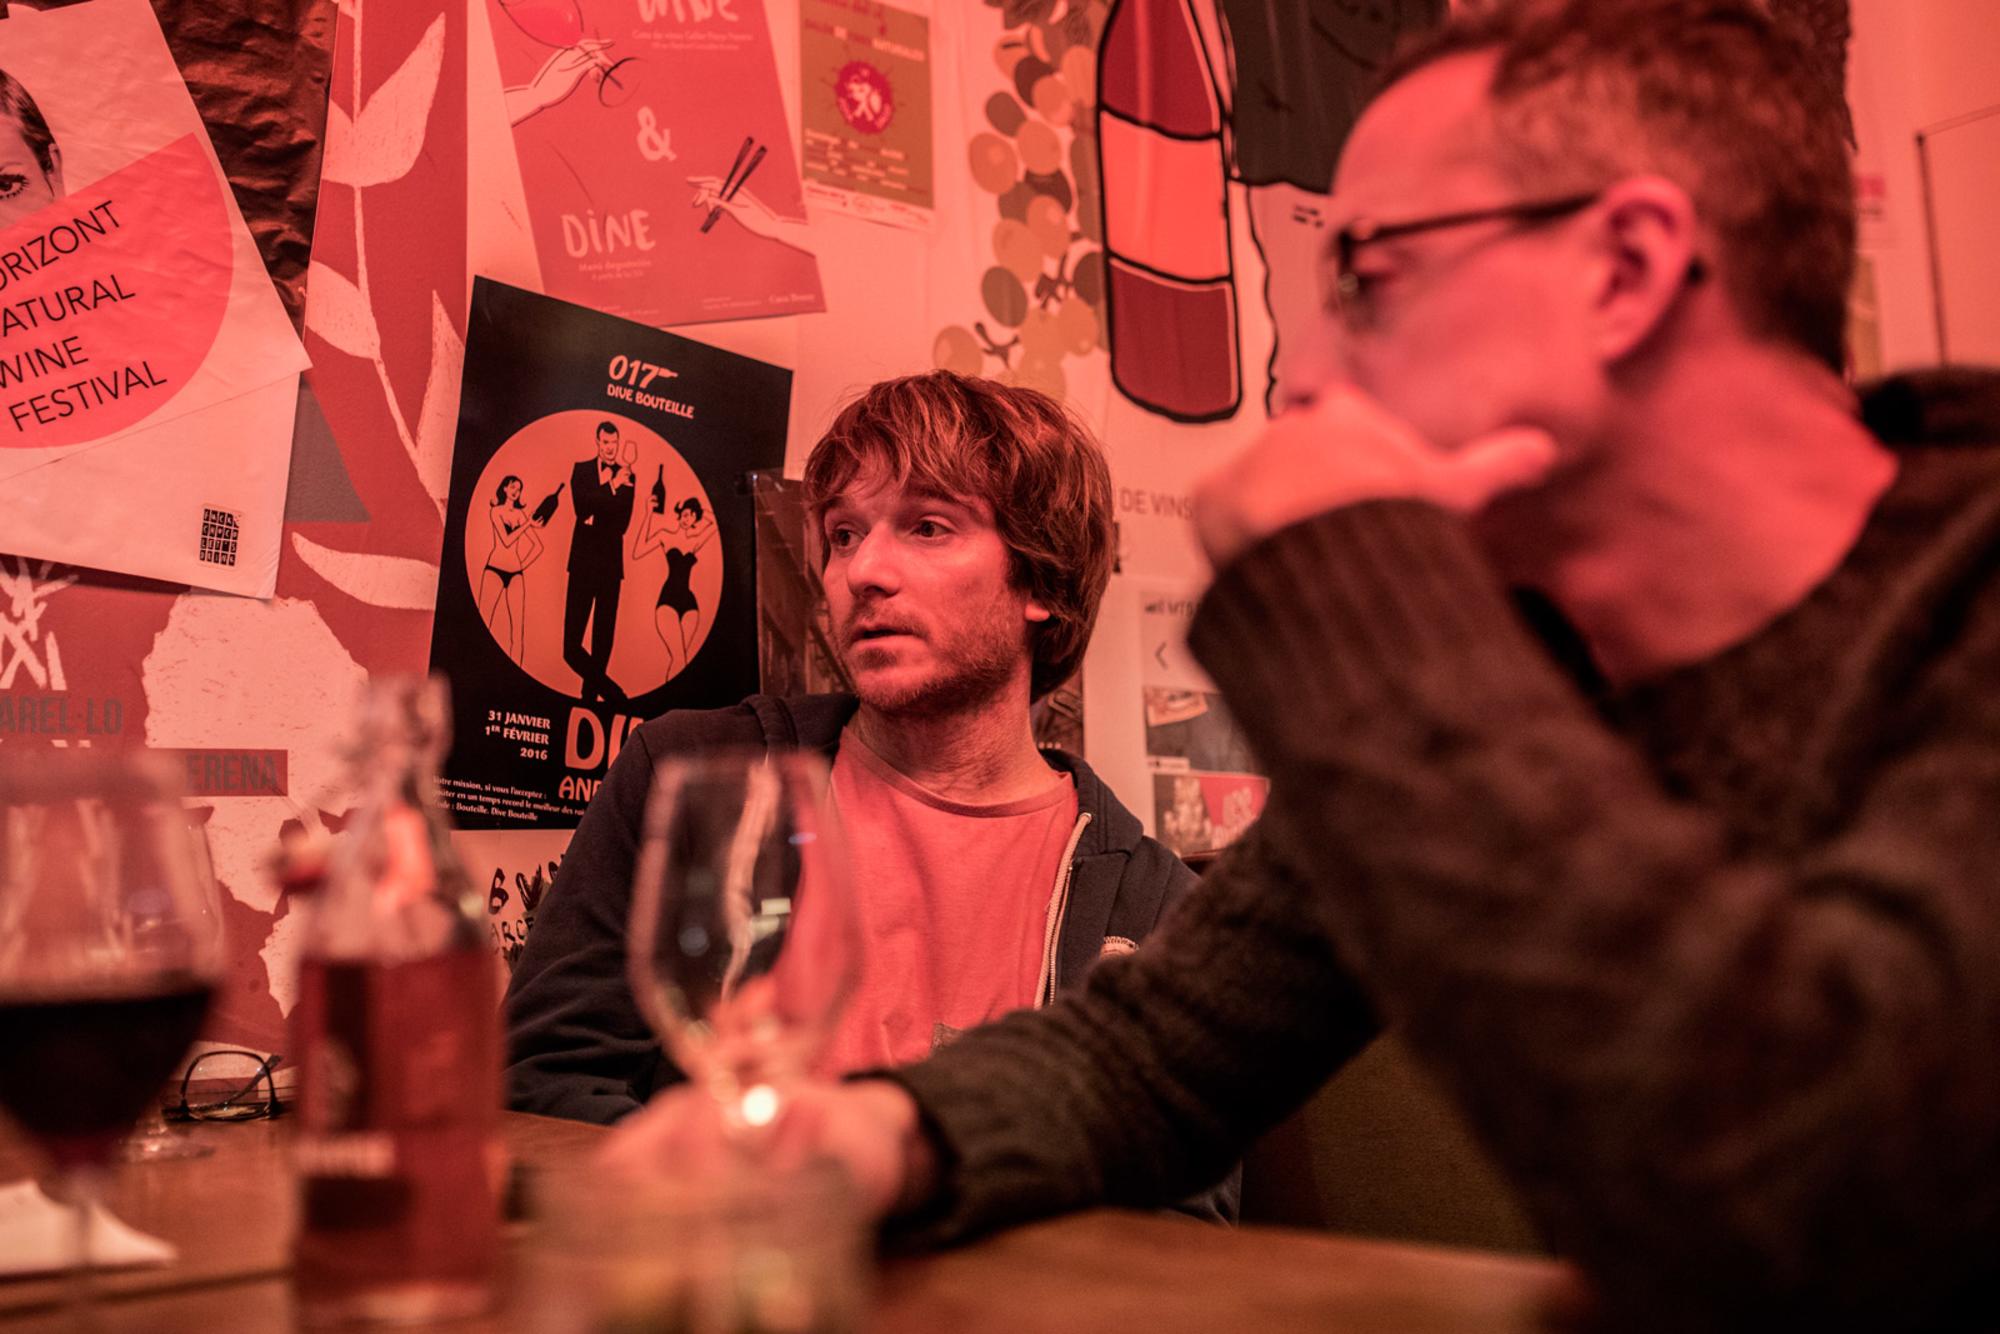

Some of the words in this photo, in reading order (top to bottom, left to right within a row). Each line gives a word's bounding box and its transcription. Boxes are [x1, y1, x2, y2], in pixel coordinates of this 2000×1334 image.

[636, 106, 677, 162] &
[0, 200, 120, 292] RIZONT
[608, 355, 660, 389] 017
[8, 361, 168, 432] FESTIVAL
[607, 384, 633, 402] DIVE
[635, 391, 695, 419] BOUTEILLE
[1119, 486, 1147, 514] DE
[488, 710, 502, 721] 31
[504, 712, 550, 730] JANVIER
[503, 727, 549, 745] FÉVRIER
[520, 747, 548, 760] 2016
[565, 706, 644, 770] DI
